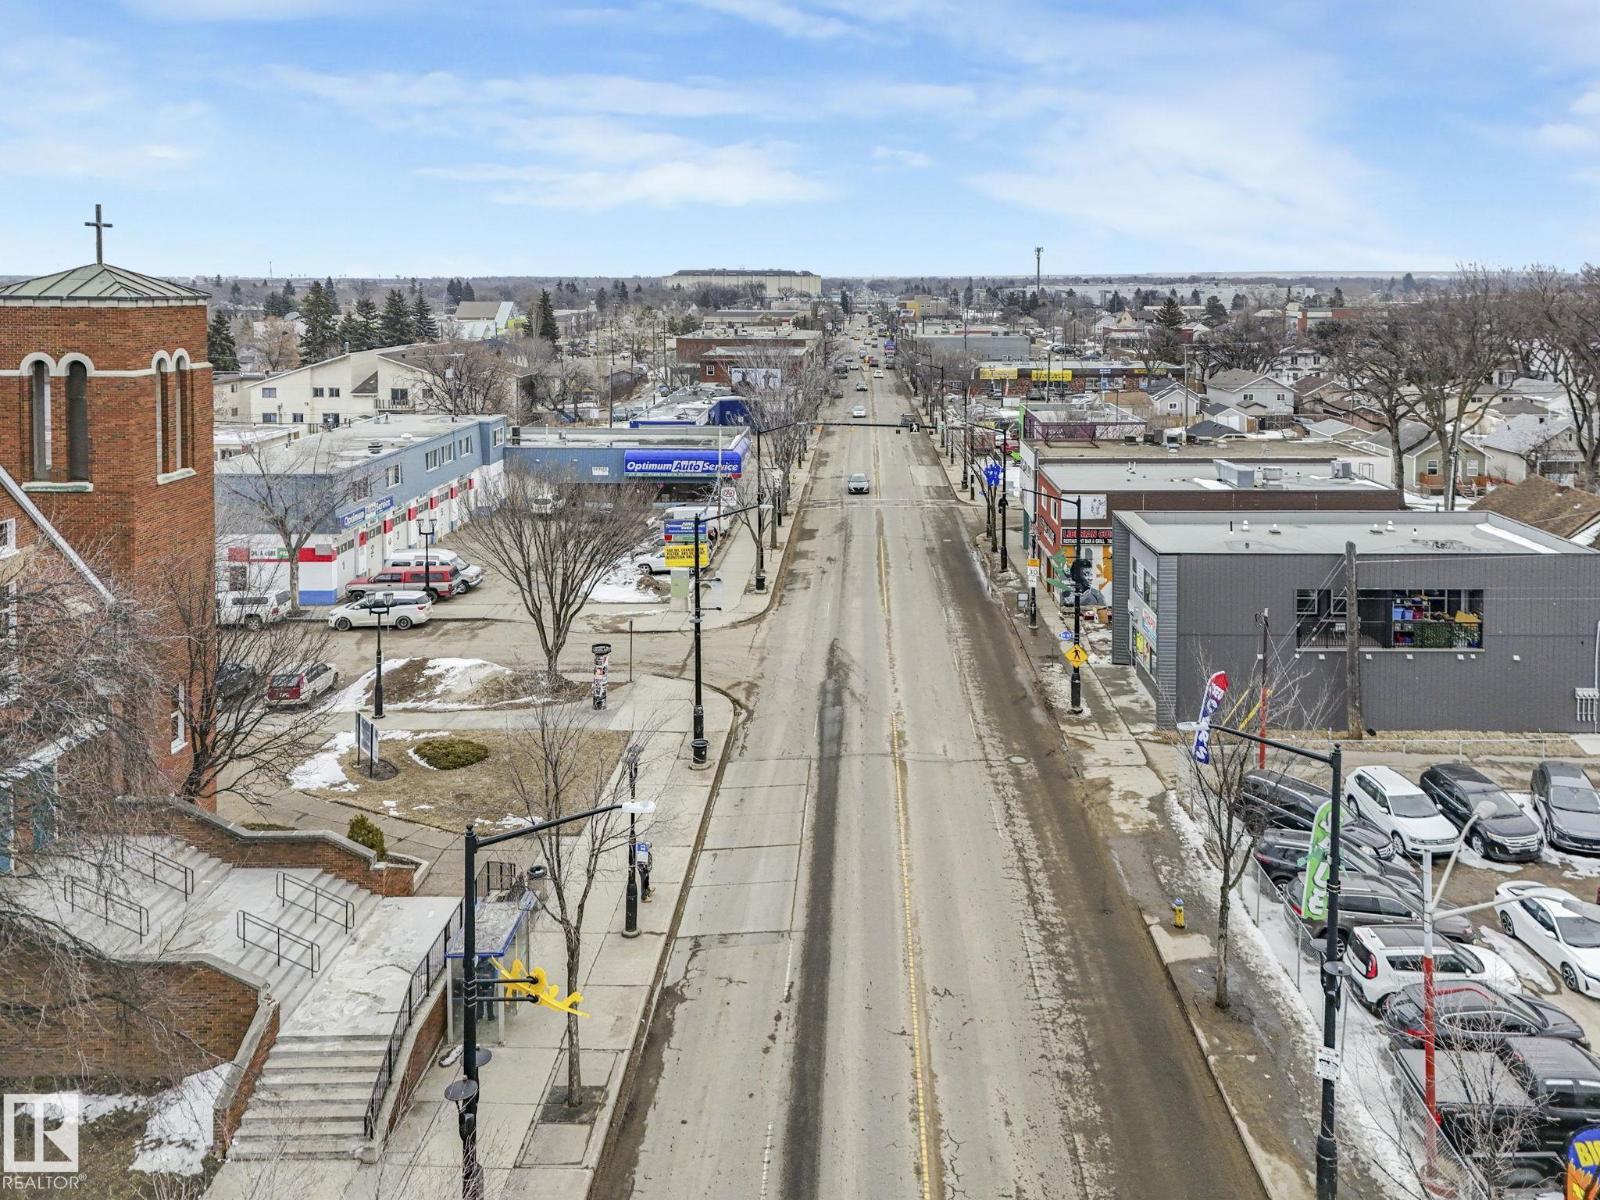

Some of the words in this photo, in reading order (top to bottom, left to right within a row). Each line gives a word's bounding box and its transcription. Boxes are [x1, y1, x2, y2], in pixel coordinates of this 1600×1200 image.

[626, 461, 672, 471] Optimum
[673, 461, 702, 472] Auto
[702, 462, 739, 471] Service
[370, 544, 375, 557] 2
[1195, 700, 1218, 760] CRS
